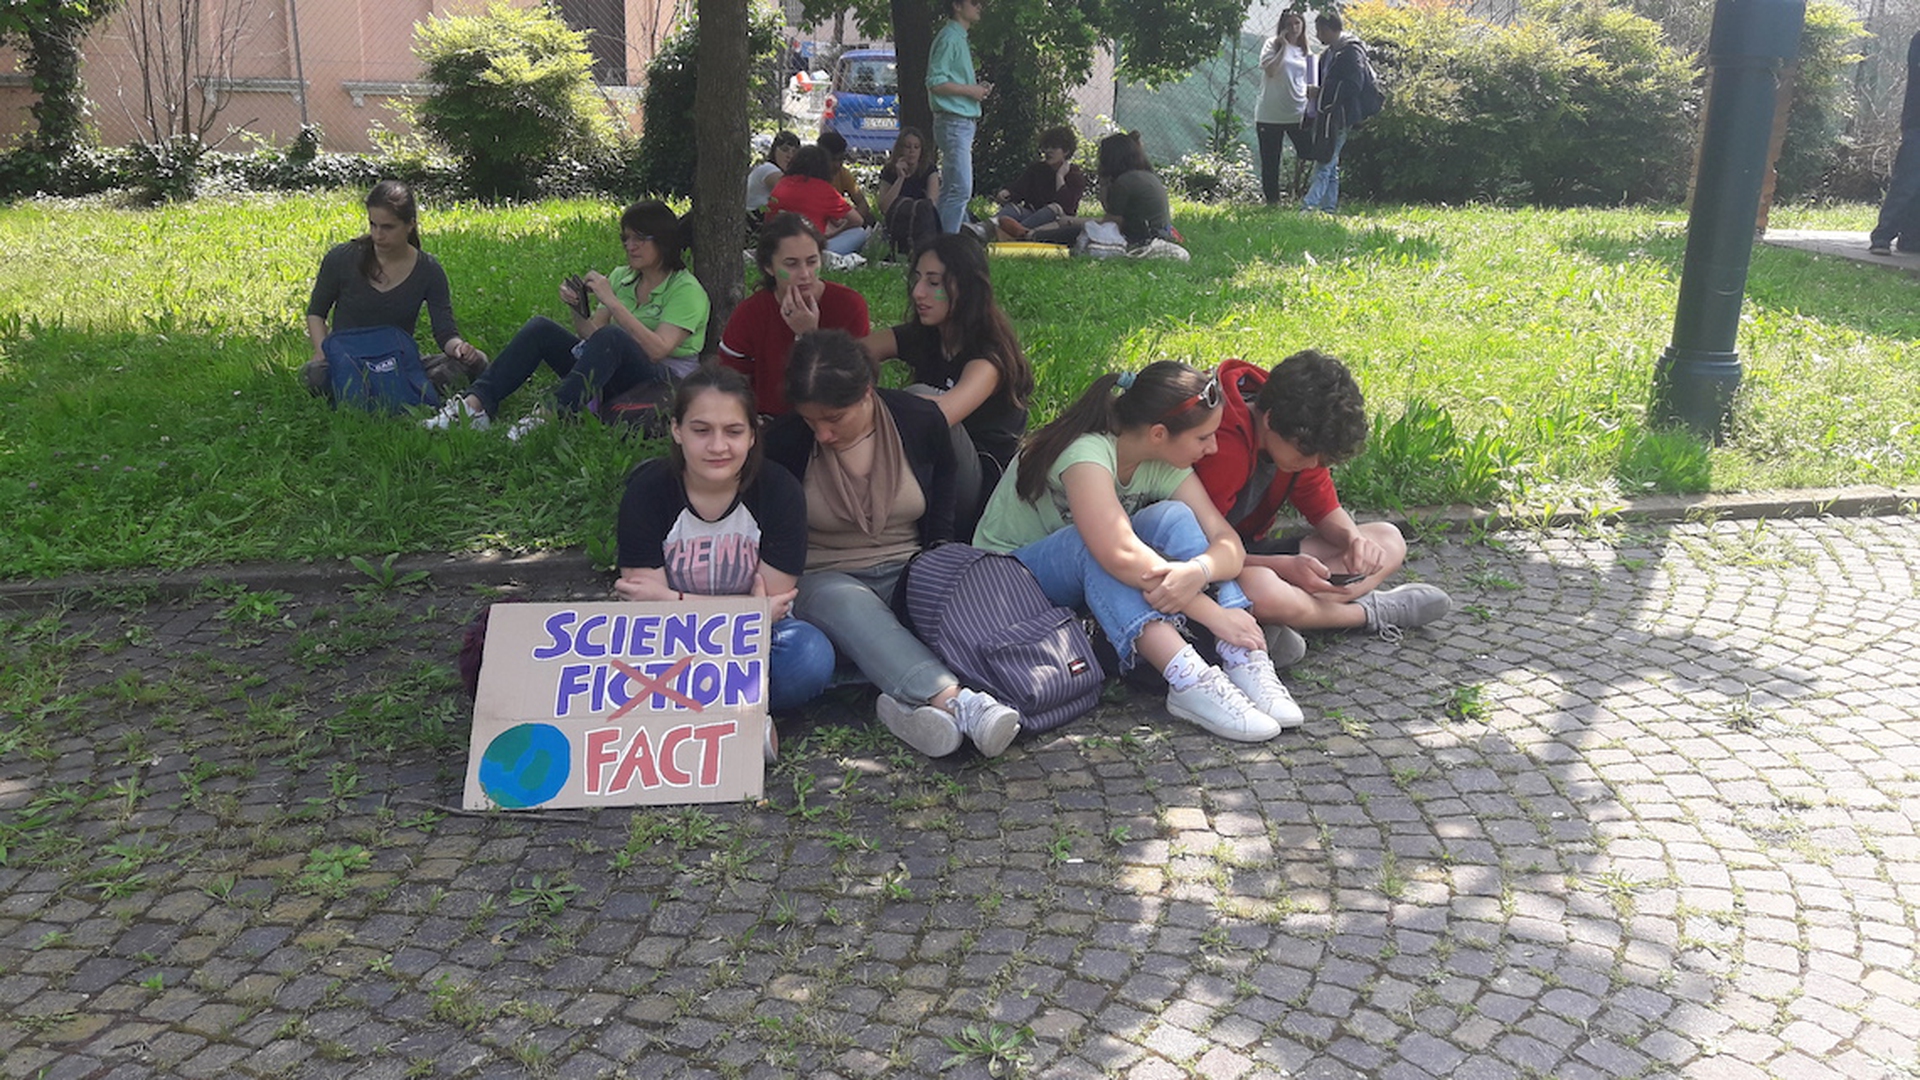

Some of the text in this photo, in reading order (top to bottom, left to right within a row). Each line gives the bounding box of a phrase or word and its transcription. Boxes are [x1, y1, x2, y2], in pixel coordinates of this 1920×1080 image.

[715, 532, 760, 570] WH
[532, 610, 762, 660] SCIENCE
[554, 660, 763, 718] FICTION
[585, 720, 737, 796] FACT
